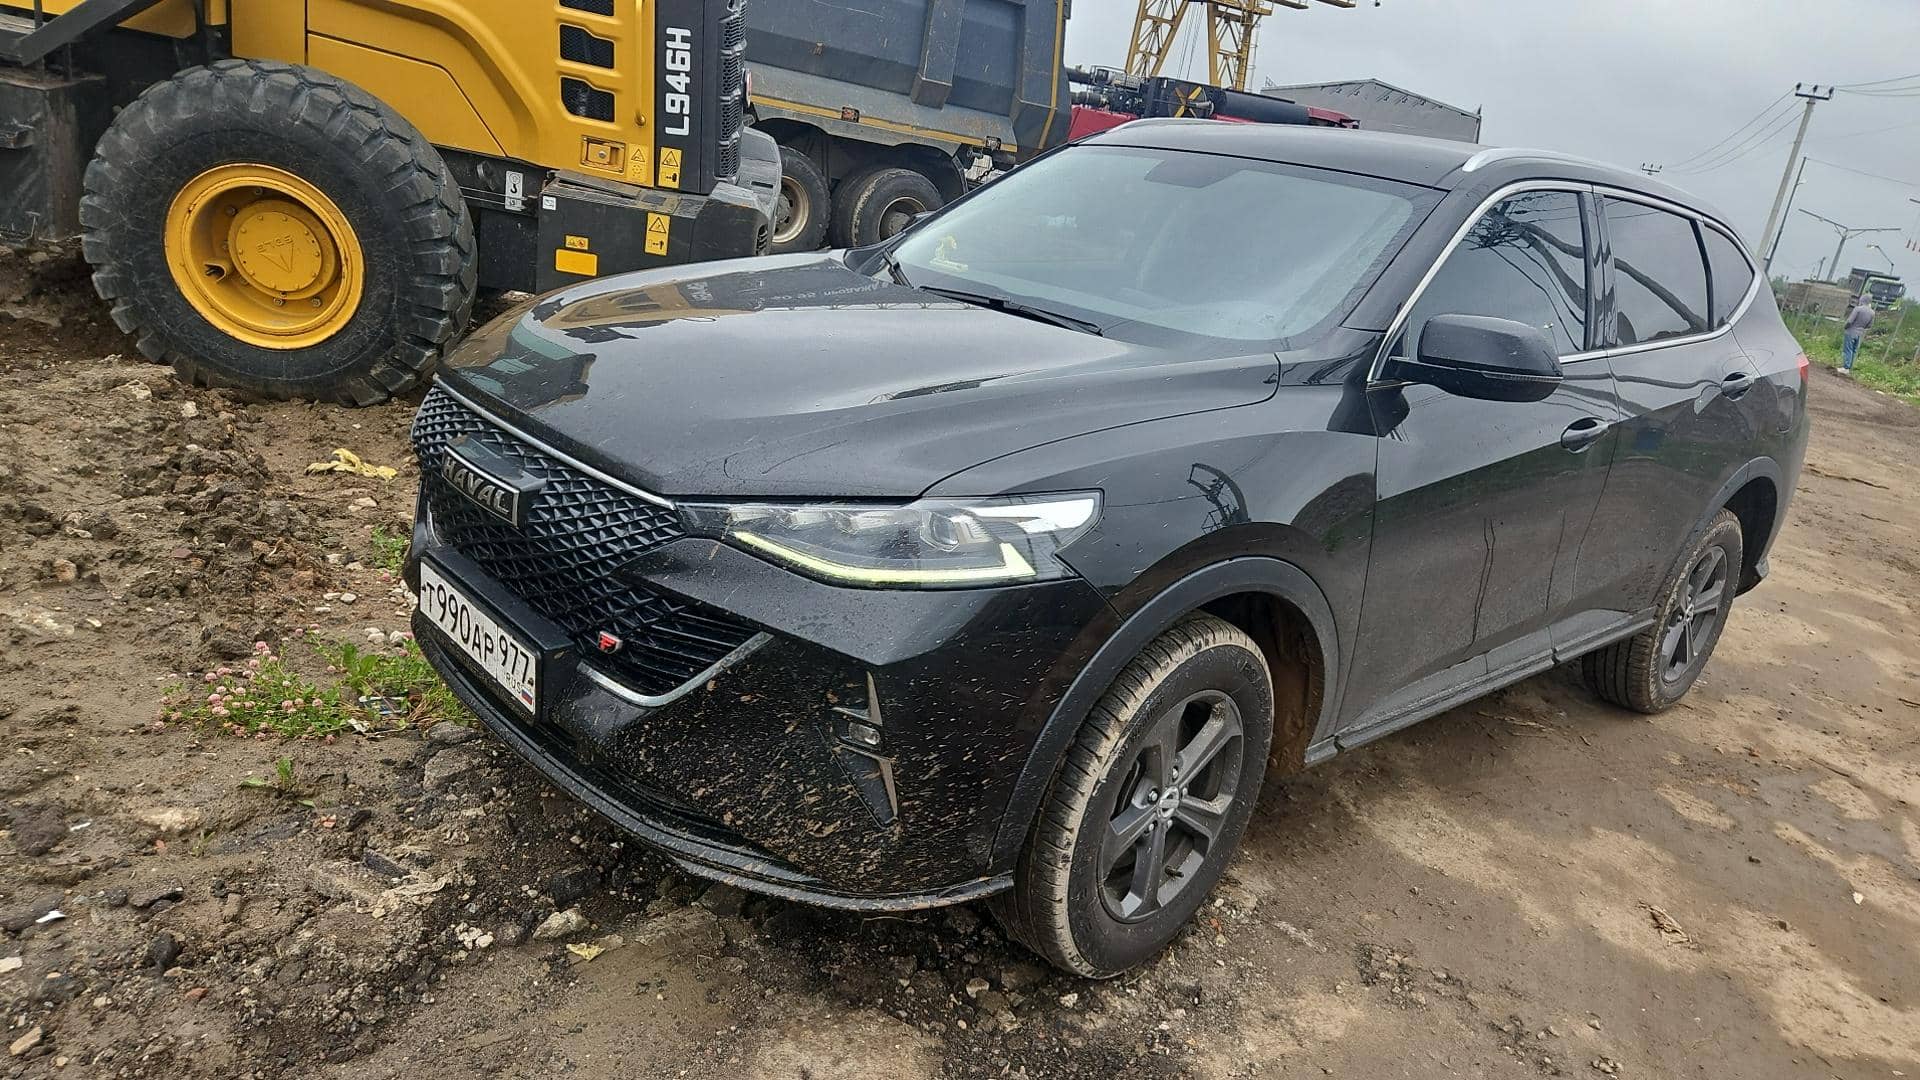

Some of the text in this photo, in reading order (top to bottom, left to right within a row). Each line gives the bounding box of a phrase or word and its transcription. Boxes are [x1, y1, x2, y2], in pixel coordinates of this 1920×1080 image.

[665, 27, 691, 136] L946H
[443, 456, 510, 515] HAVAL
[499, 634, 529, 684] 977
[505, 672, 521, 694] RUS
